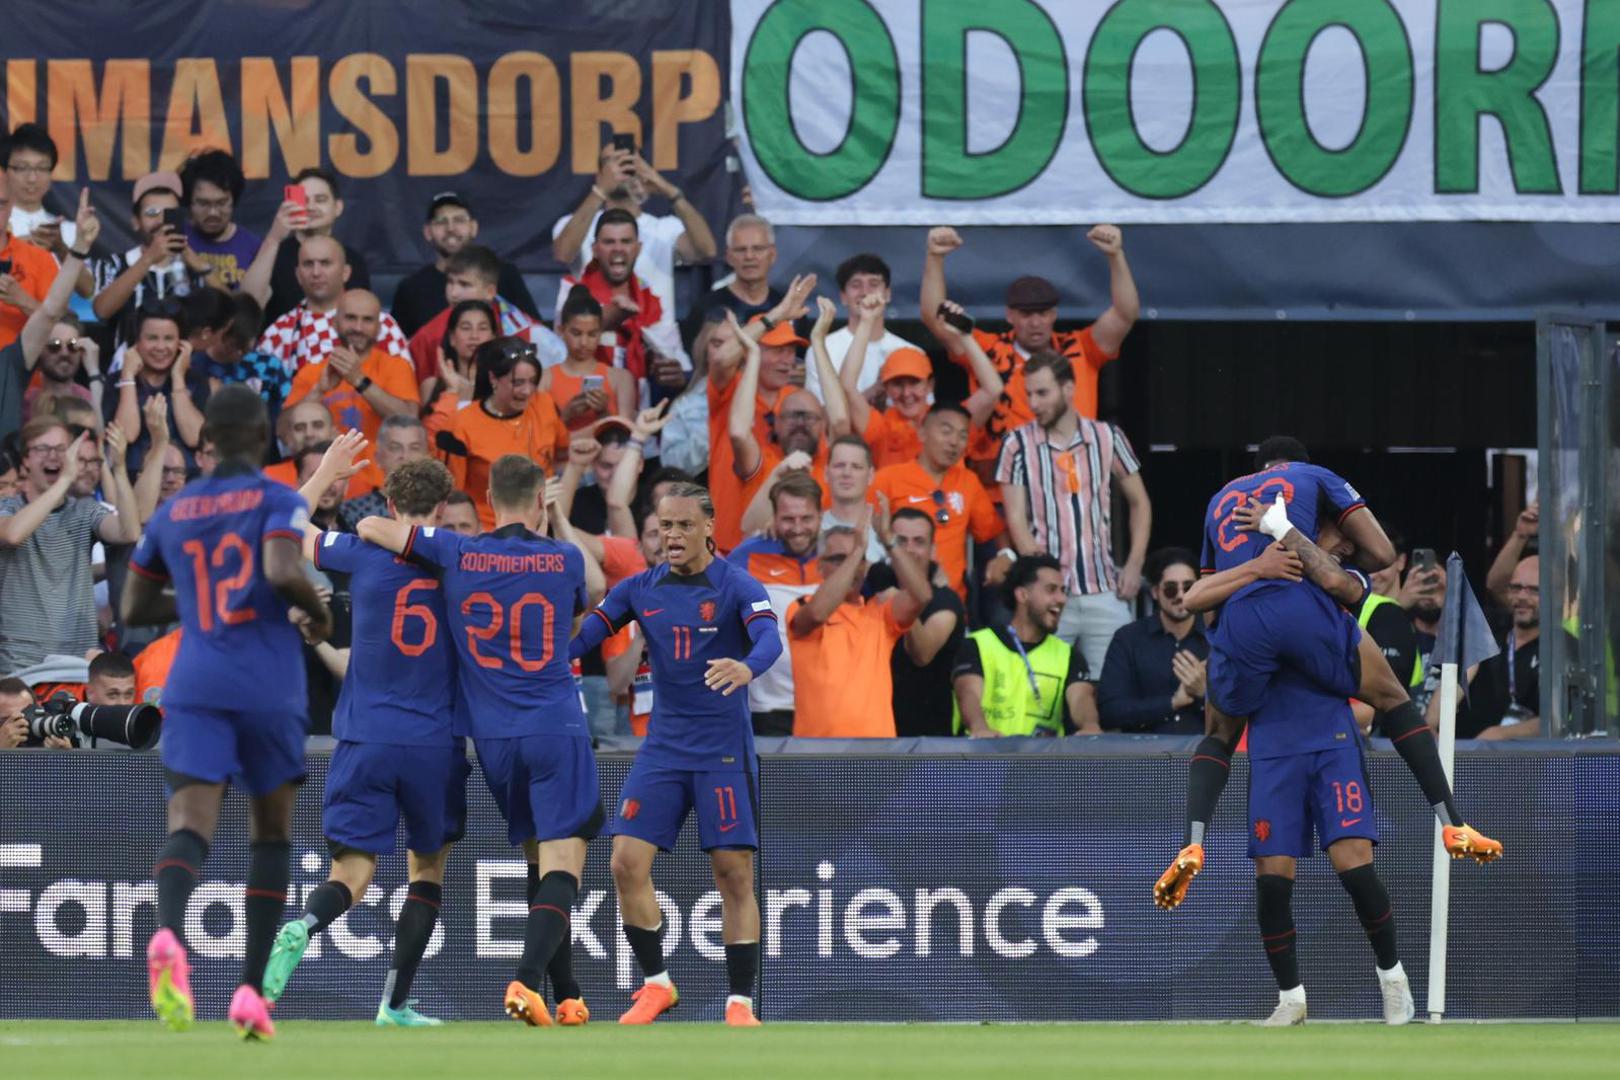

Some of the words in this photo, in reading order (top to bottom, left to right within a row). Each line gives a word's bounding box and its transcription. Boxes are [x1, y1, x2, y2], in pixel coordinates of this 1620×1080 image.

[182, 532, 257, 632] 12
[460, 552, 565, 573] KOOPMEINERS
[391, 578, 440, 657] 6
[461, 592, 555, 672] 20
[672, 625, 691, 660] 11
[714, 785, 737, 821] 11
[1331, 780, 1363, 813] 18
[0, 843, 446, 958] anaics
